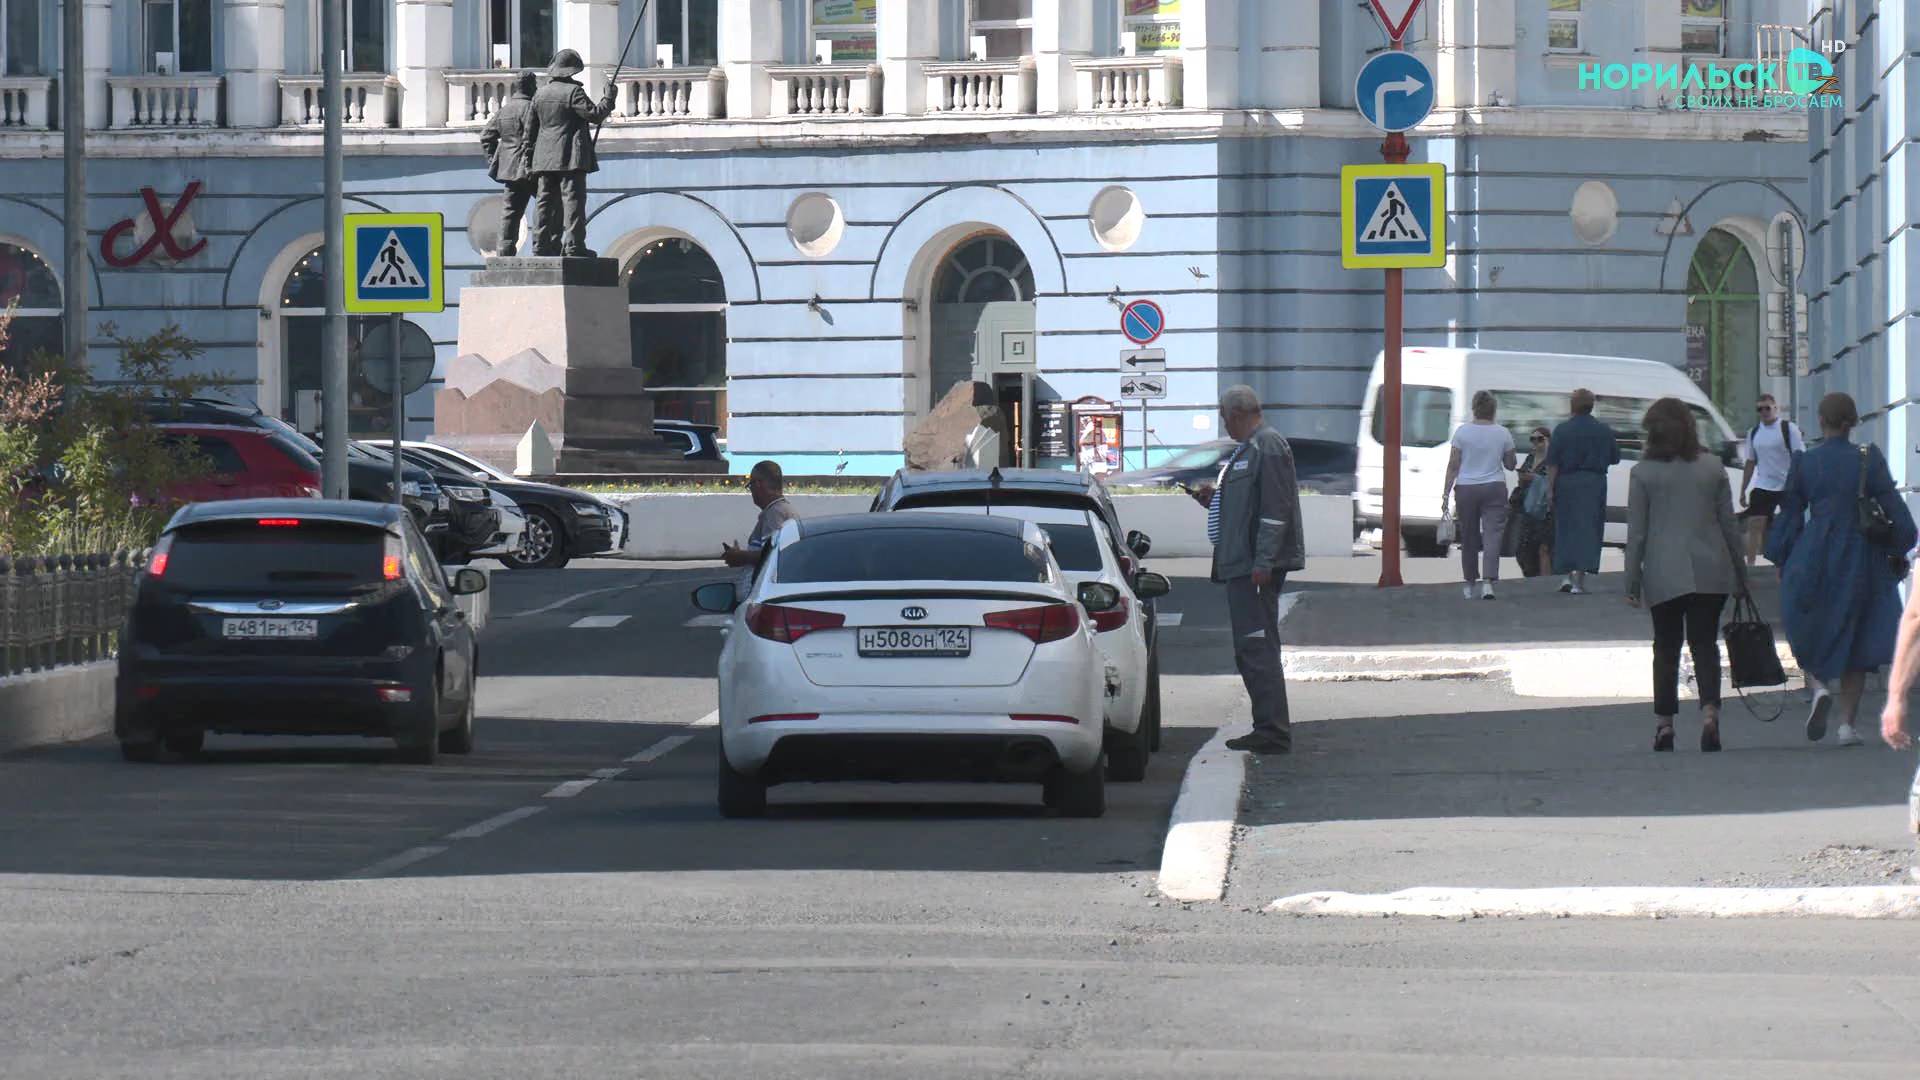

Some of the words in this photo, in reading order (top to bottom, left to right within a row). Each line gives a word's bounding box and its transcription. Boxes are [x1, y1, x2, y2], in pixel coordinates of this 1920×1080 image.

[904, 608, 926, 618] KIA
[864, 630, 935, 649] Н508ОН
[938, 629, 965, 644] 124
